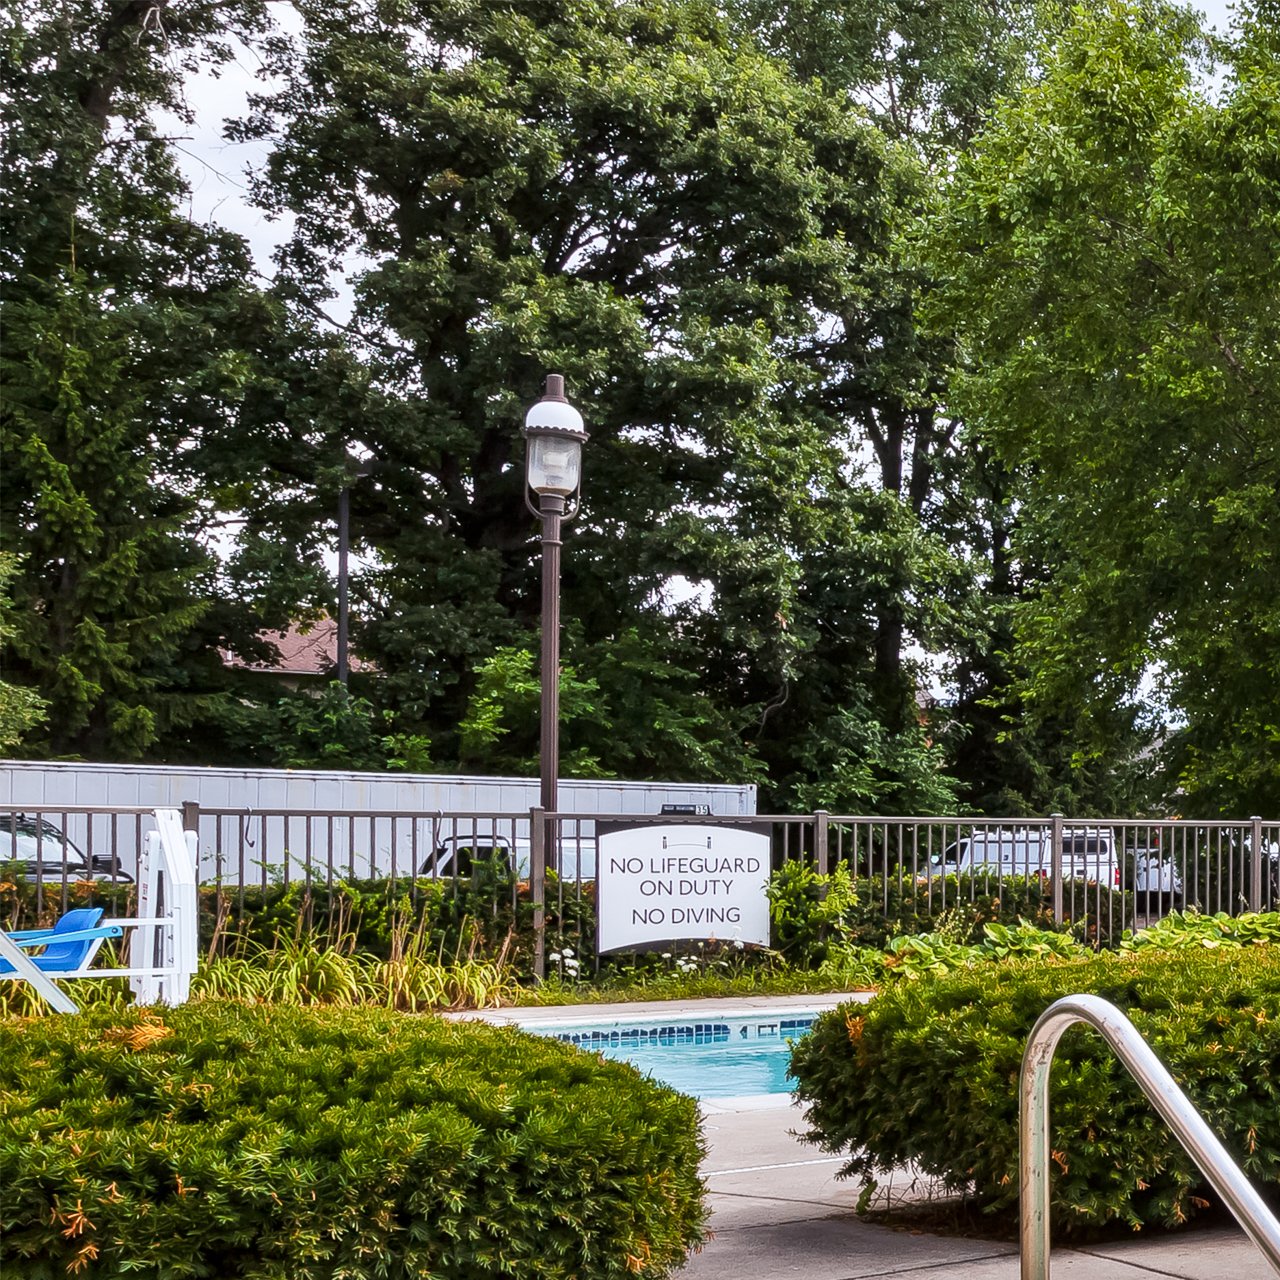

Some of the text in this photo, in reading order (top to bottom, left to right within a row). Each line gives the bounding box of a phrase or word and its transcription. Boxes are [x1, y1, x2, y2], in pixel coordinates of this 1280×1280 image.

[610, 857, 761, 874] NO LIFEGUARD
[640, 879, 734, 896] ON DUTY
[632, 906, 741, 925] NO DIVING
